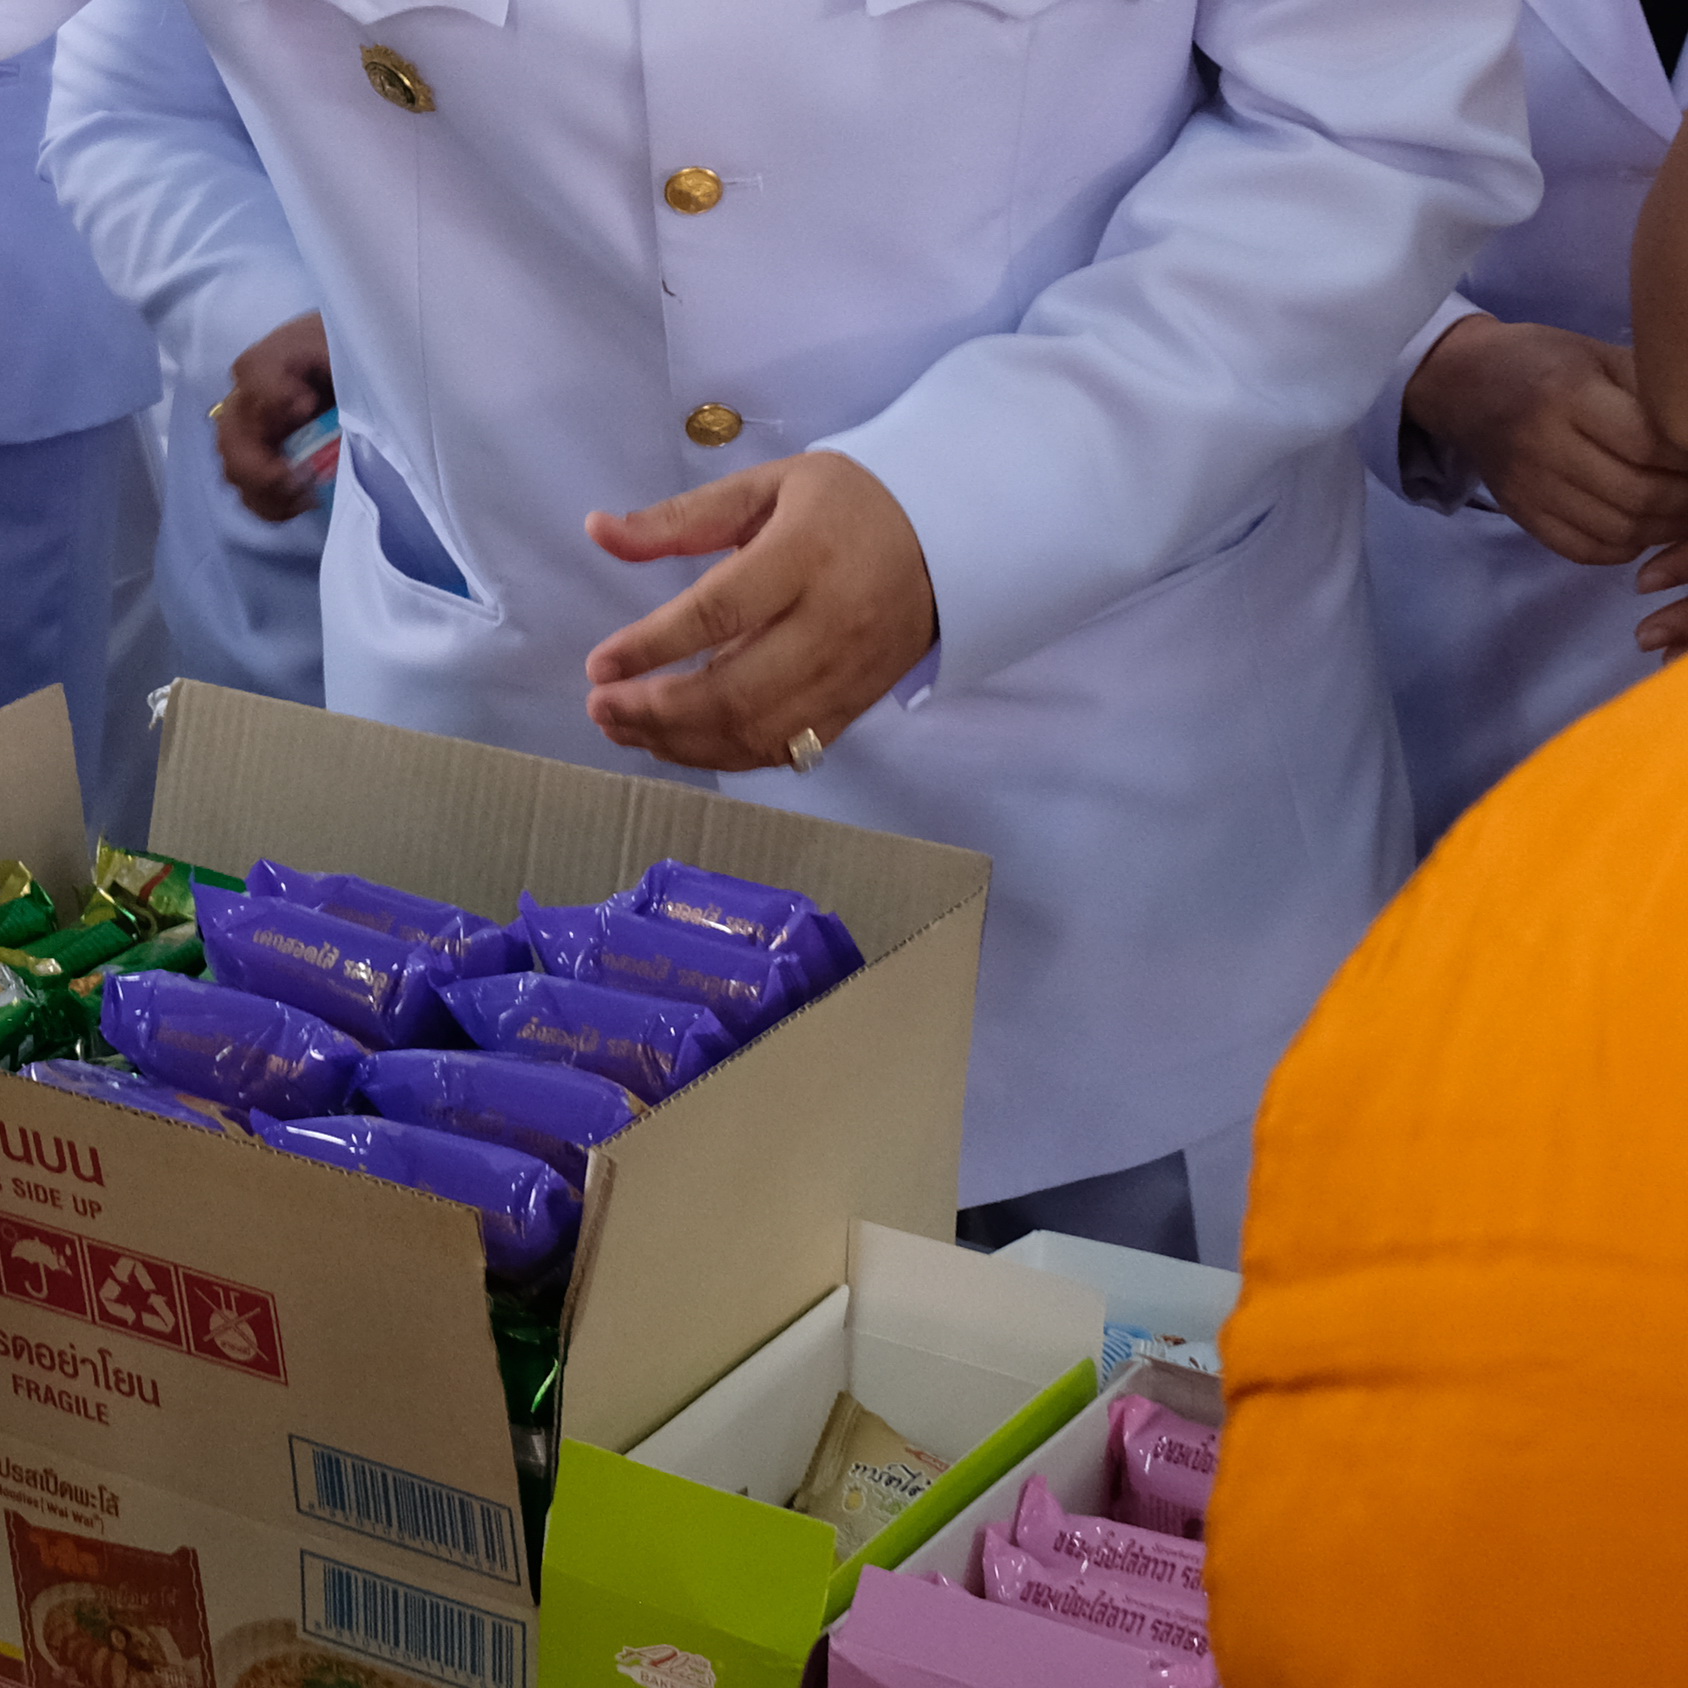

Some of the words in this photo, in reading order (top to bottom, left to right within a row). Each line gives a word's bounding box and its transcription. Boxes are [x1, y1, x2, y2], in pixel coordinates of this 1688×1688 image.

[11, 1176, 63, 1210] SIDE
[72, 1193, 103, 1220] UP
[11, 1372, 111, 1426] FRAGILE
